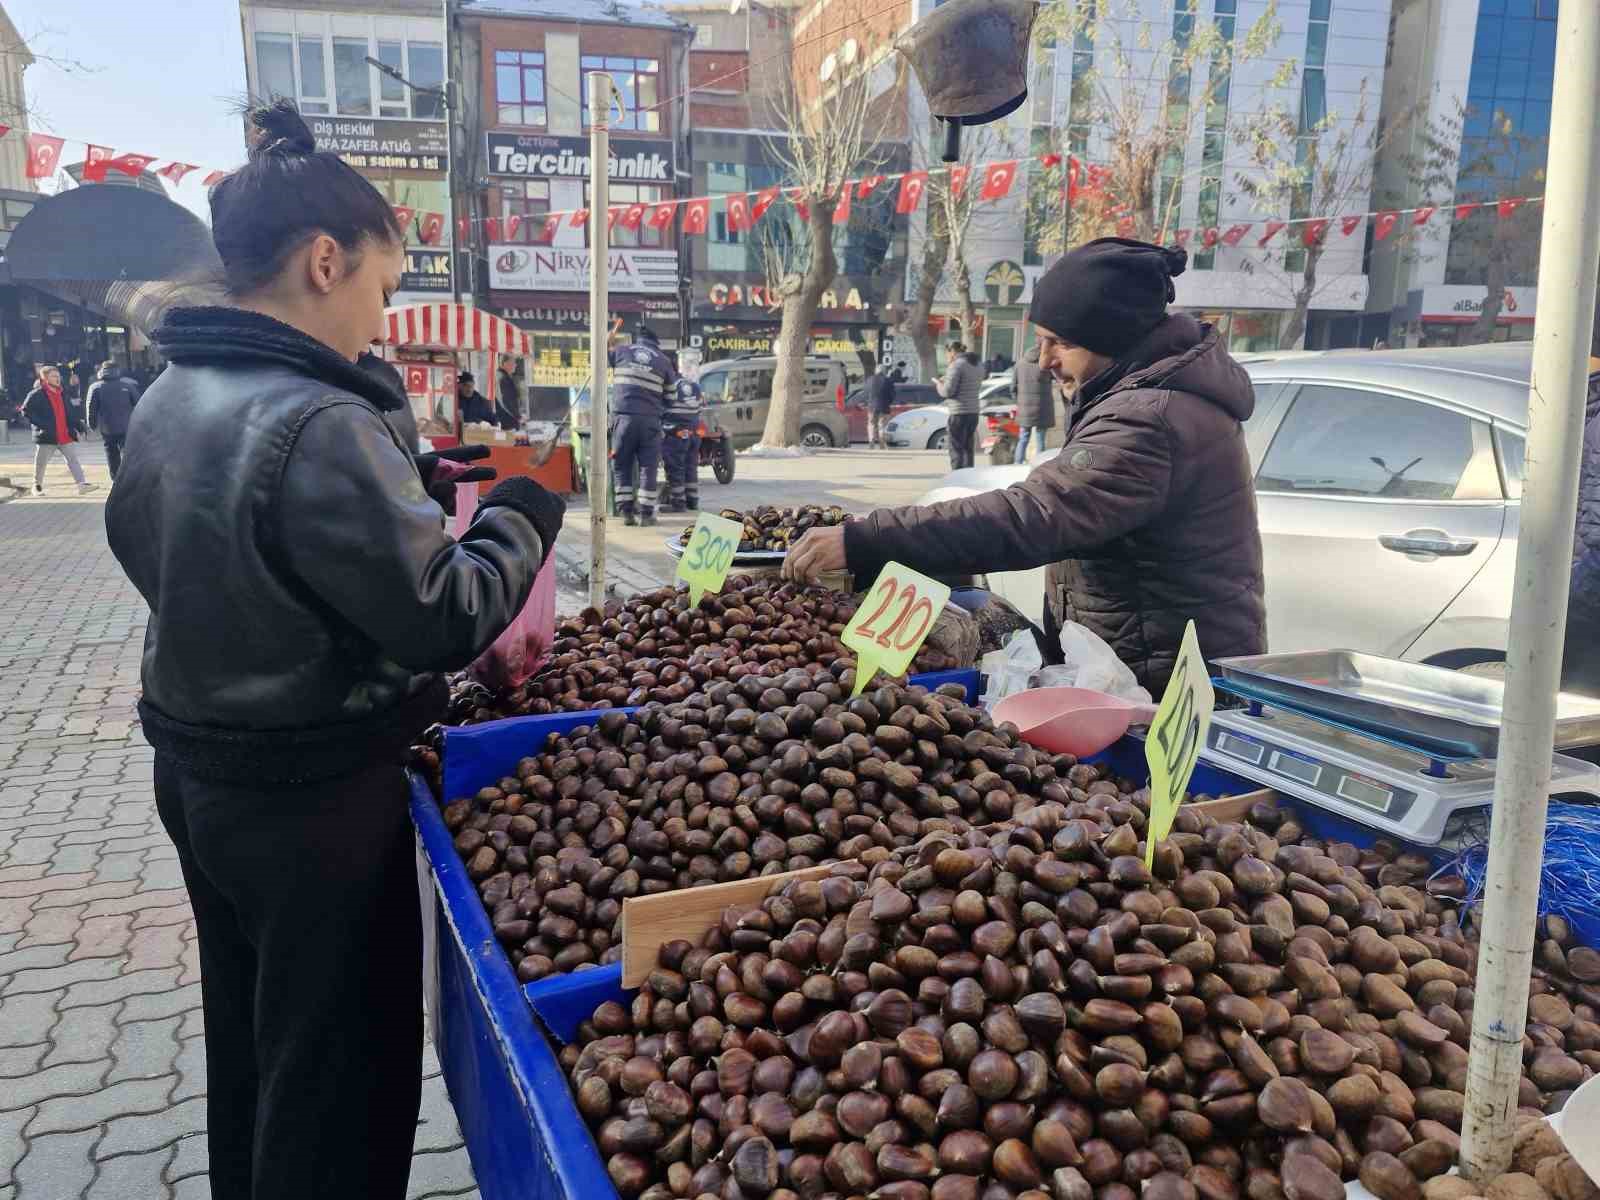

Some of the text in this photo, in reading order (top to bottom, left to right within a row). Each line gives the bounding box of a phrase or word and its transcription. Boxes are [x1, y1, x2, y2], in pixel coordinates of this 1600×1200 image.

[314, 120, 375, 137] DİŞ HEKİMİ
[341, 139, 378, 152] ZAFER
[379, 139, 412, 153] ATUĞ
[369, 155, 407, 169] satım
[535, 251, 632, 276] NİRVA
[708, 337, 770, 352] ÇAKIRLAR
[687, 525, 733, 574] 300
[855, 576, 933, 651] 220
[1157, 655, 1200, 801] 200
